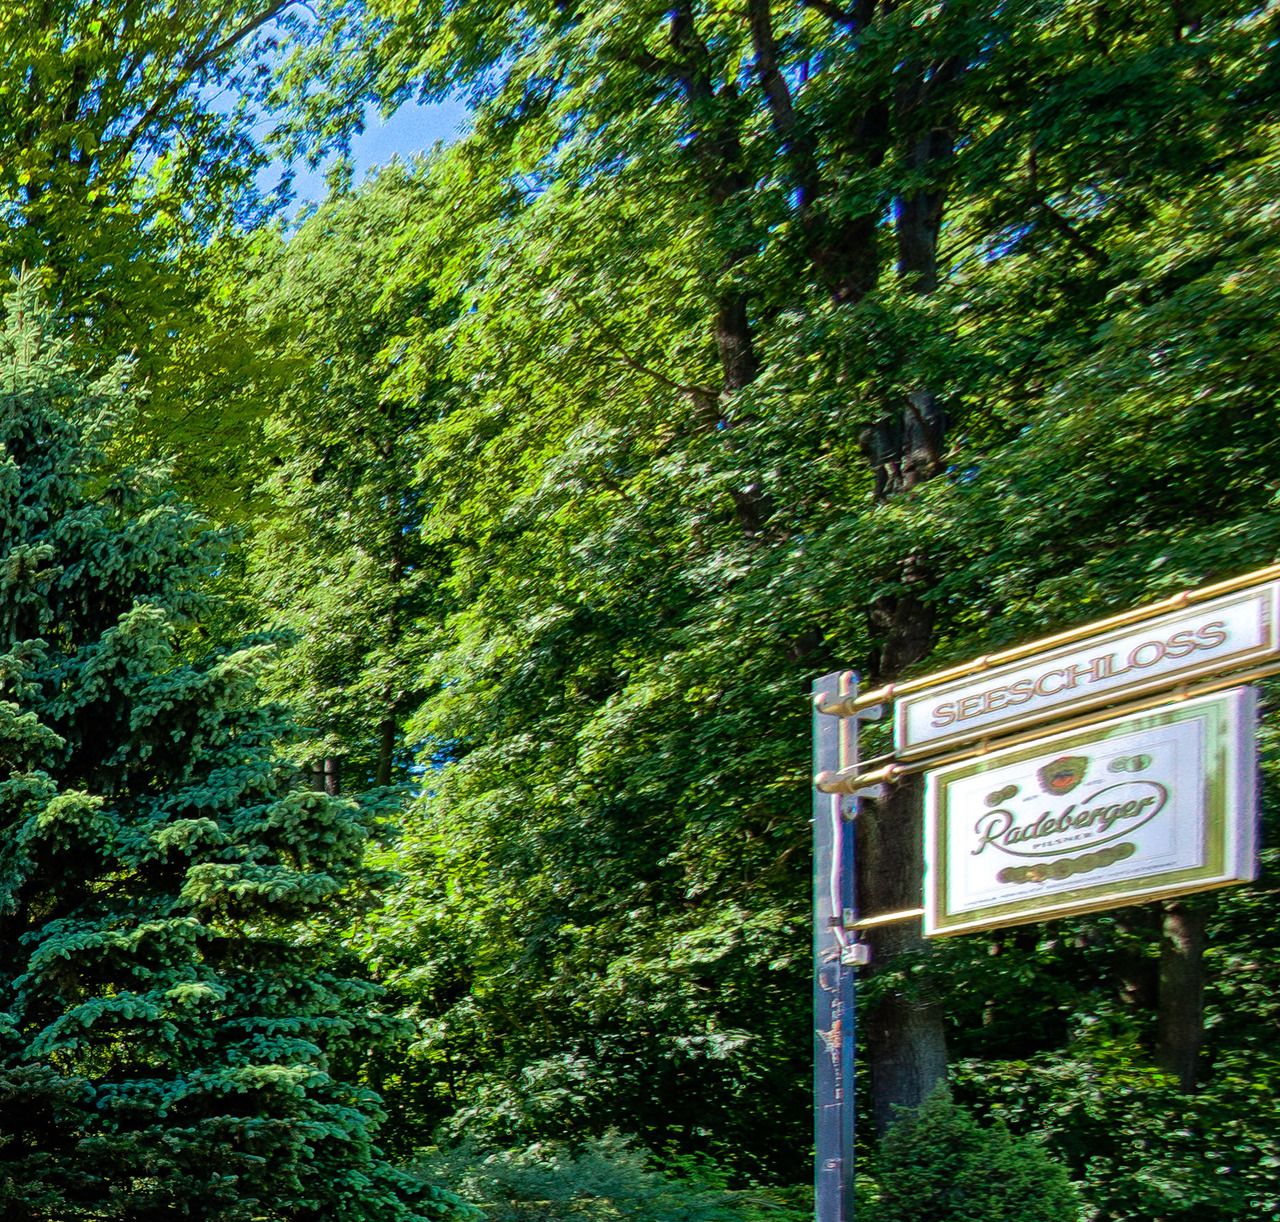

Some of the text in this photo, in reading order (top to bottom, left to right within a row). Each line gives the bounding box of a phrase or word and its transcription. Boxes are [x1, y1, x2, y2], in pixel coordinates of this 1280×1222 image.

[931, 621, 1227, 728] SEESCHLOSS
[971, 788, 1163, 856] Radeberger
[1032, 832, 1093, 849] PILSNER
